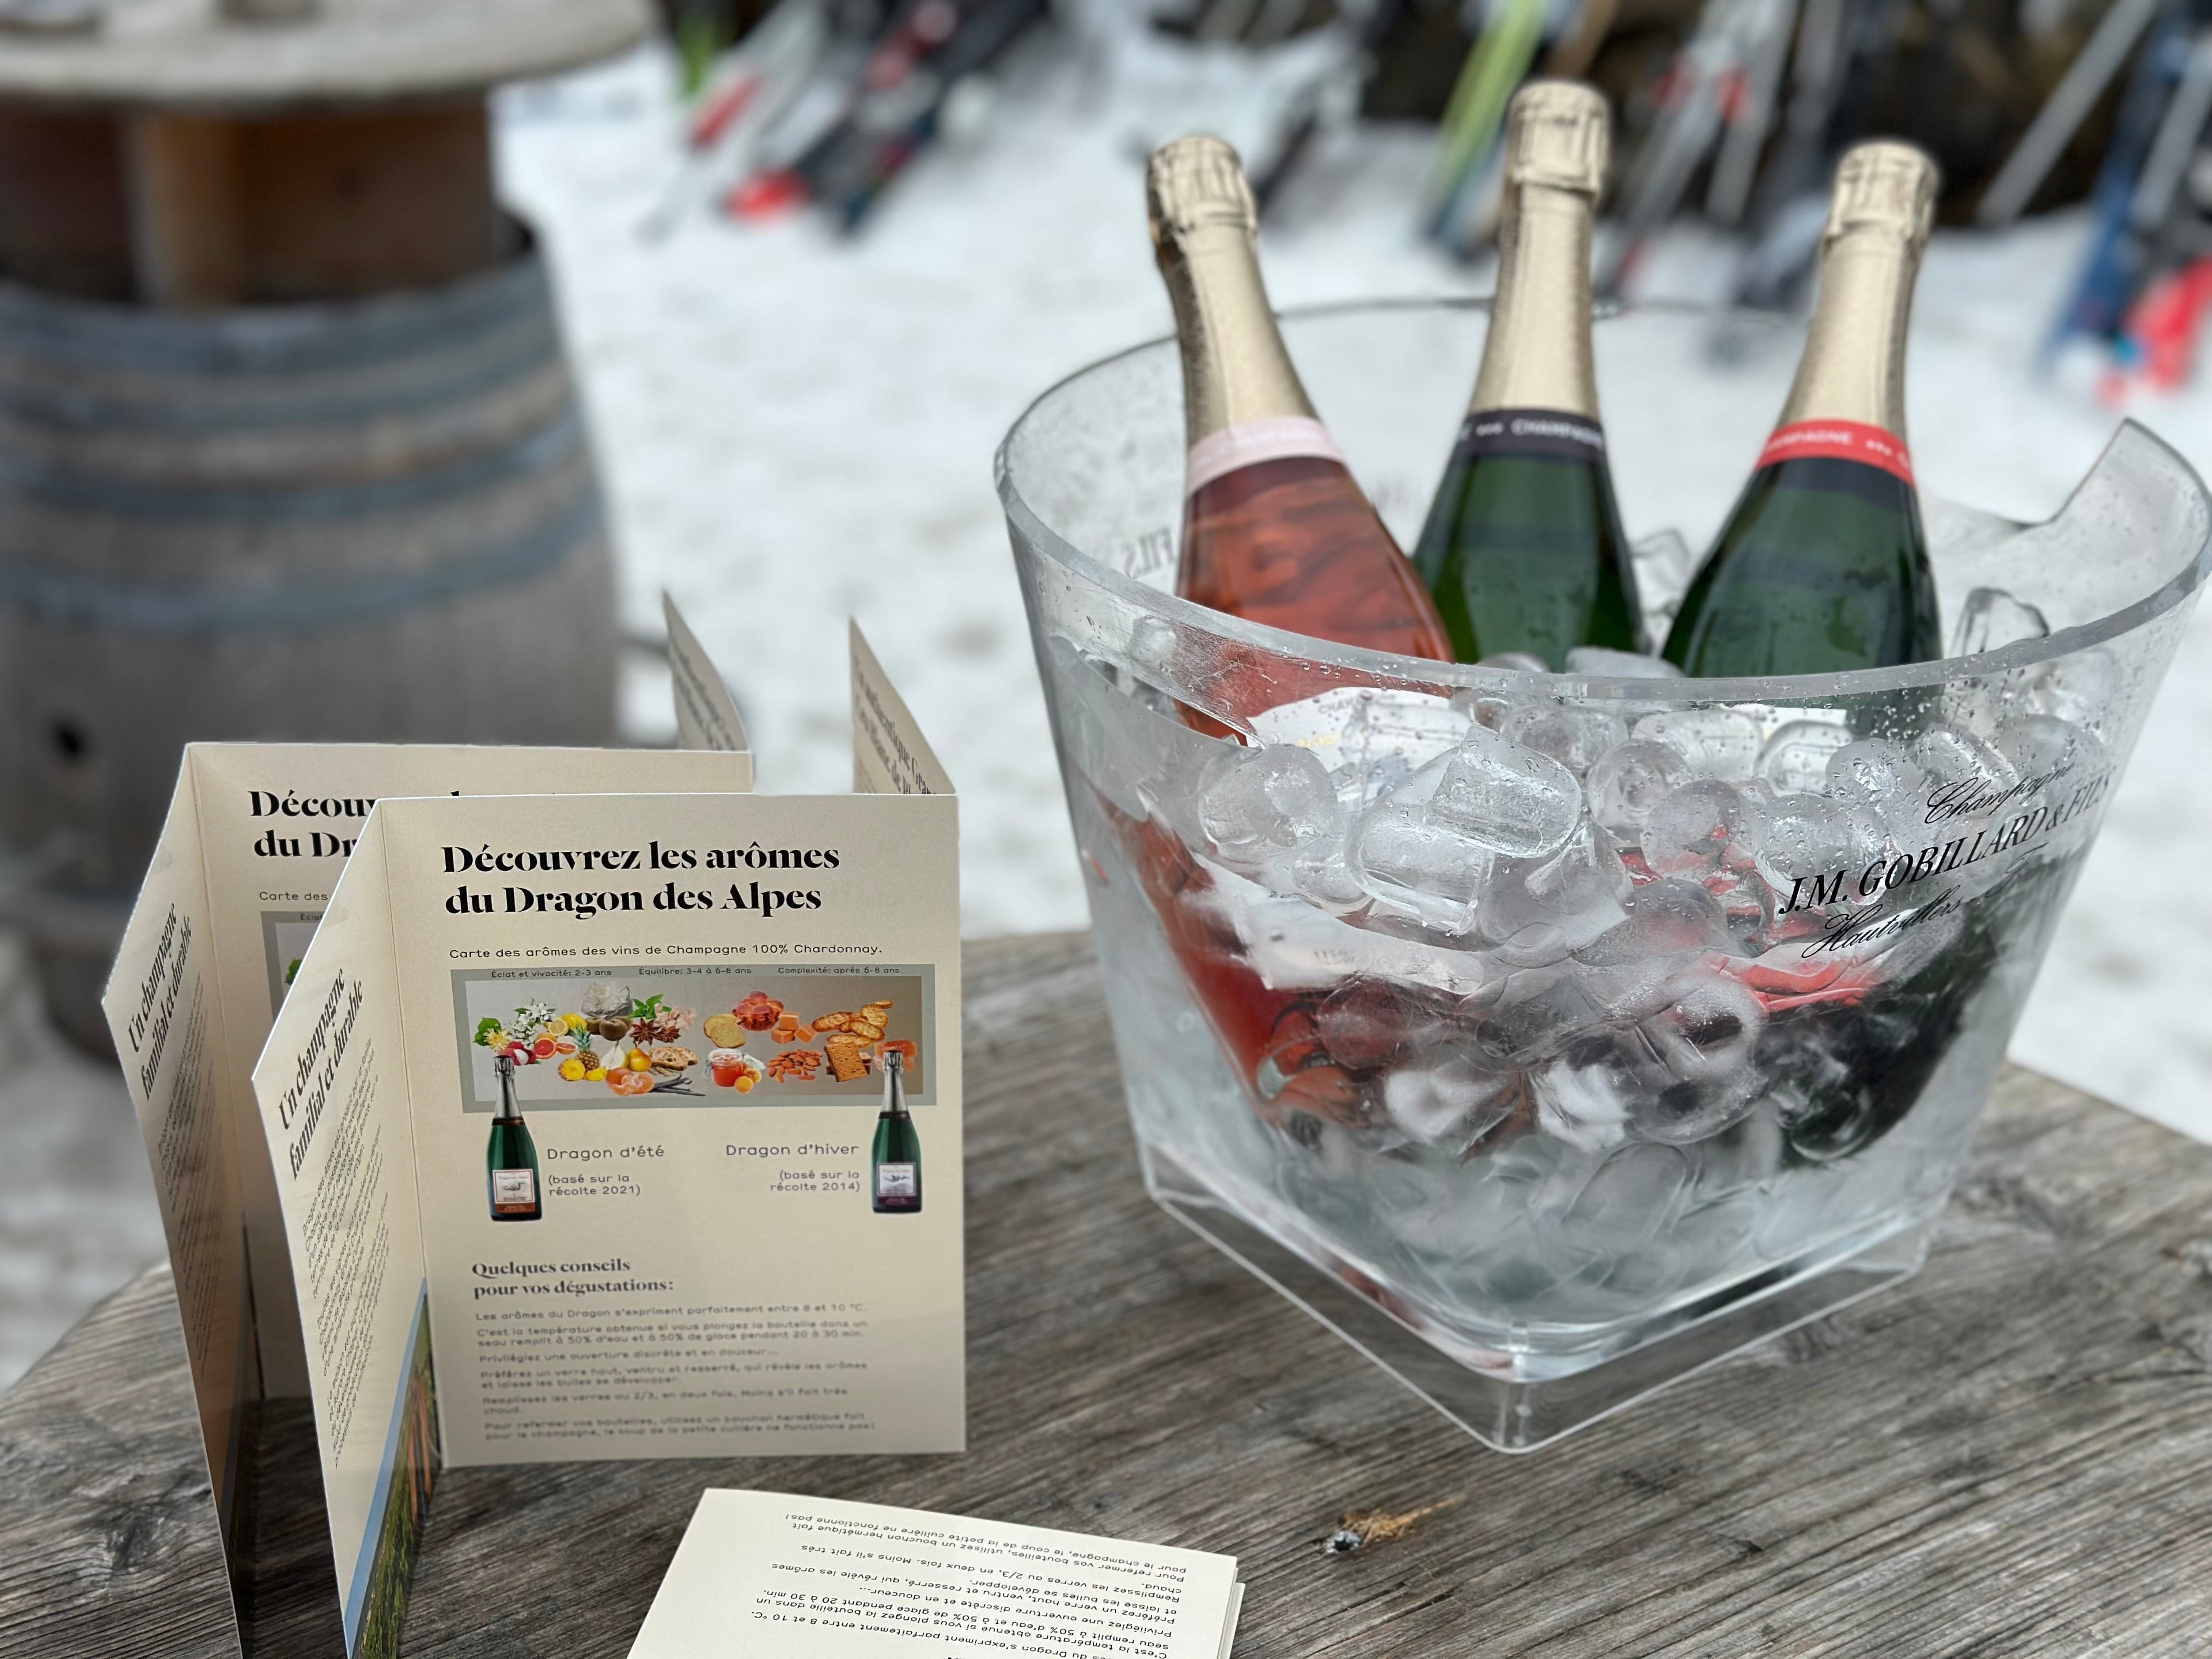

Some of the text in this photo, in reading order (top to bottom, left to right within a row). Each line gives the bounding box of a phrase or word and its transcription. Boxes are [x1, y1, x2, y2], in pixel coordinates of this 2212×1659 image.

[1924, 762, 2075, 824] Champagne
[248, 789, 376, 817] Découv
[253, 830, 302, 857] du
[441, 840, 839, 873] Découvrez les arômes
[1778, 869, 1848, 914] J.M.
[1859, 806, 2048, 896] GOBILLARD
[2045, 804, 2064, 831] &
[259, 891, 328, 901] Carte des
[445, 881, 821, 921] du Dragon des Alpes
[449, 943, 882, 959] Carte des arômes des vins de Champagne 100% Chardonnay.
[491, 969, 516, 979] Éclat
[686, 967, 702, 975] 3-4
[715, 967, 732, 975] 6-8
[834, 966, 861, 975] après
[864, 966, 880, 974] 6-8
[128, 902, 177, 1053] Un champagne
[141, 914, 192, 1102] familial et durable
[279, 1088, 297, 1130] Un
[296, 968, 345, 1091] champagne
[289, 1071, 326, 1181] familial
[324, 1055, 334, 1091] et
[334, 980, 363, 1068] durable
[547, 1145, 664, 1162] Dragon d'été
[726, 1143, 859, 1158] Dragon d'hiver
[548, 1173, 585, 1185] (basé
[618, 1174, 630, 1183] la
[779, 1169, 816, 1182] (basé
[848, 1170, 859, 1179] la
[549, 1184, 641, 1197] récolte 2021)
[770, 1181, 860, 1194] récolte 2014)
[472, 1257, 631, 1280] Quelques conseils
[474, 1278, 673, 1301] pour vos dégustations:
[801, 1545, 825, 1554] très
[831, 1548, 852, 1557] fait
[878, 1554, 912, 1564] Moins
[916, 1559, 942, 1568] fois.
[771, 1563, 815, 1573] arômes
[820, 1569, 836, 1577] les
[946, 1563, 975, 1572] deux
[840, 1571, 878, 1581] révèle
[998, 1570, 1023, 1580] 2/3,
[905, 1578, 962, 1592] resserré,
[970, 1580, 1040, 1594] développer.
[1047, 1577, 1087, 1588] verres
[1092, 1584, 1108, 1592] les
[763, 1590, 787, 1598] min.
[859, 1587, 921, 1600] douceur...
[1141, 1583, 1182, 1594] chaud.
[790, 1593, 806, 1601] 30
[810, 1595, 818, 1603] à
[983, 1590, 1023, 1600] ventru
[1062, 1593, 1098, 1604] bulles
[1113, 1586, 1180, 1603] Remplissez
[775, 1600, 805, 1609] dans
[842, 1599, 893, 1610] pendant
[960, 1601, 1010, 1612] discrète
[1028, 1595, 1060, 1607] haut,
[1064, 1601, 1097, 1611] verre
[1103, 1599, 1120, 1607] les
[809, 1604, 862, 1616] bouteille
[897, 1606, 929, 1615] glace
[1124, 1602, 1160, 1613] laisse
[751, 1611, 768, 1619] °C.
[772, 1613, 787, 1622] 10
[880, 1612, 929, 1624] plongez
[953, 1613, 978, 1623] 50%
[1016, 1608, 1077, 1621] ouverture
[1121, 1609, 1175, 1624] Préférez
[822, 1619, 855, 1628] entre
[933, 1619, 962, 1628] vous
[982, 1617, 990, 1625] à
[1011, 1621, 1045, 1631] d'eau
[859, 1624, 941, 1639] parfaitement
[981, 1626, 1032, 1638] obtenue
[1050, 1627, 1074, 1636] 50%
[1080, 1631, 1087, 1639] à
[1108, 1621, 1172, 1638] Privilégiez
[945, 1635, 1017, 1650] s'expriment
[1036, 1634, 1113, 1651] température
[1092, 1633, 1135, 1644] remplit
[1139, 1640, 1169, 1650] seau
[1022, 1646, 1067, 1658] Dragon
[1134, 1648, 1167, 1659] C'est
